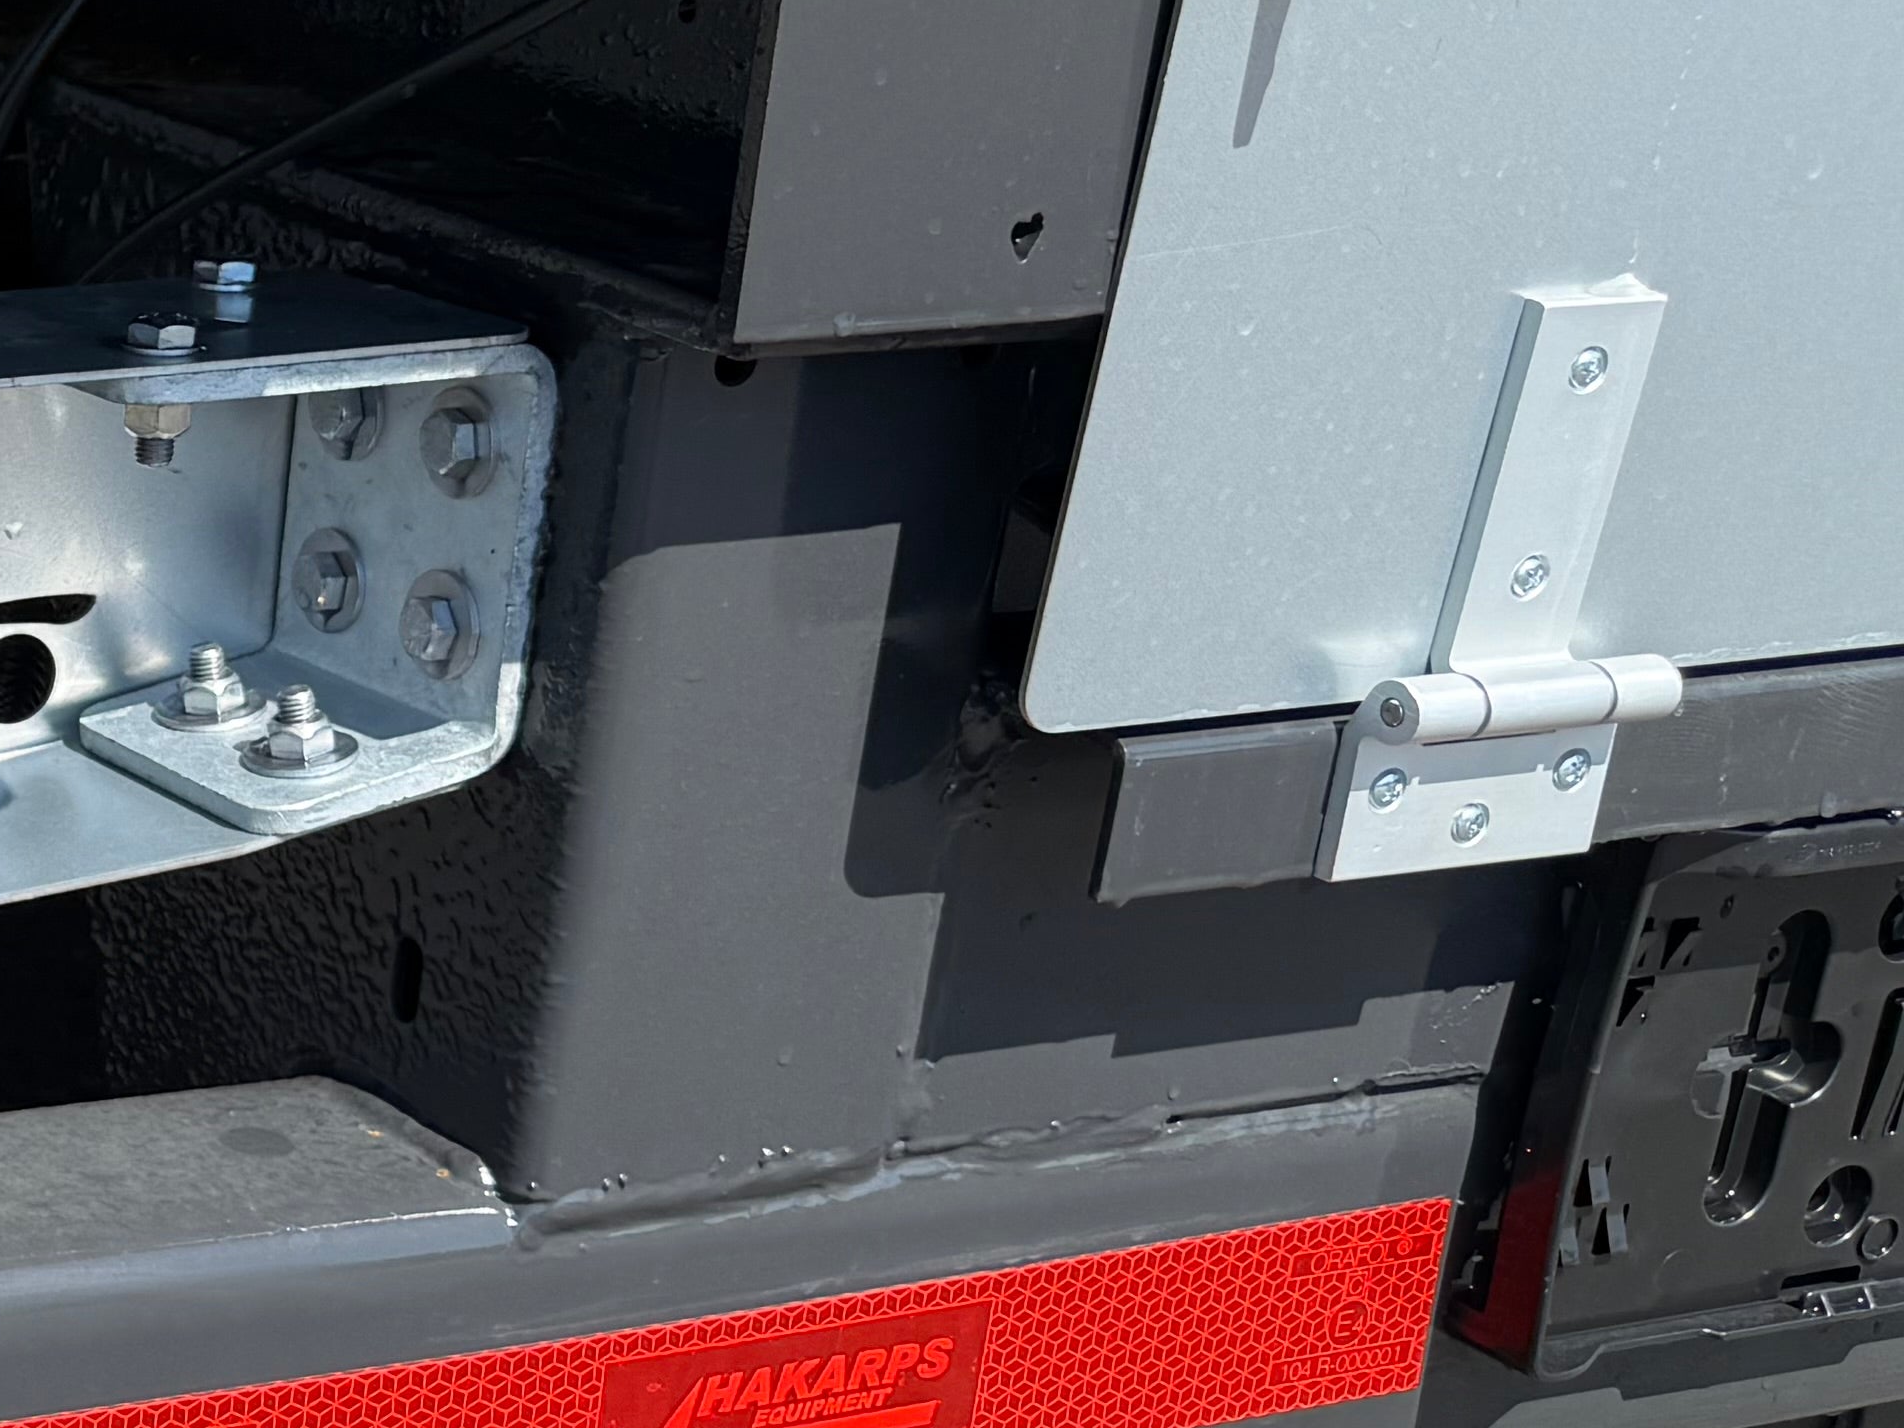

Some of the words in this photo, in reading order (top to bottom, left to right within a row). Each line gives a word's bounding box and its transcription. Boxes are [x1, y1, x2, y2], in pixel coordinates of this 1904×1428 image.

[1310, 1242, 1395, 1274] ORAFOL
[1335, 1310, 1364, 1338] E4
[697, 1337, 954, 1418] HAKARPS
[1281, 1359, 1311, 1382] 104
[1316, 1345, 1401, 1376] R-000001
[752, 1387, 892, 1428] EQUIPMENT
